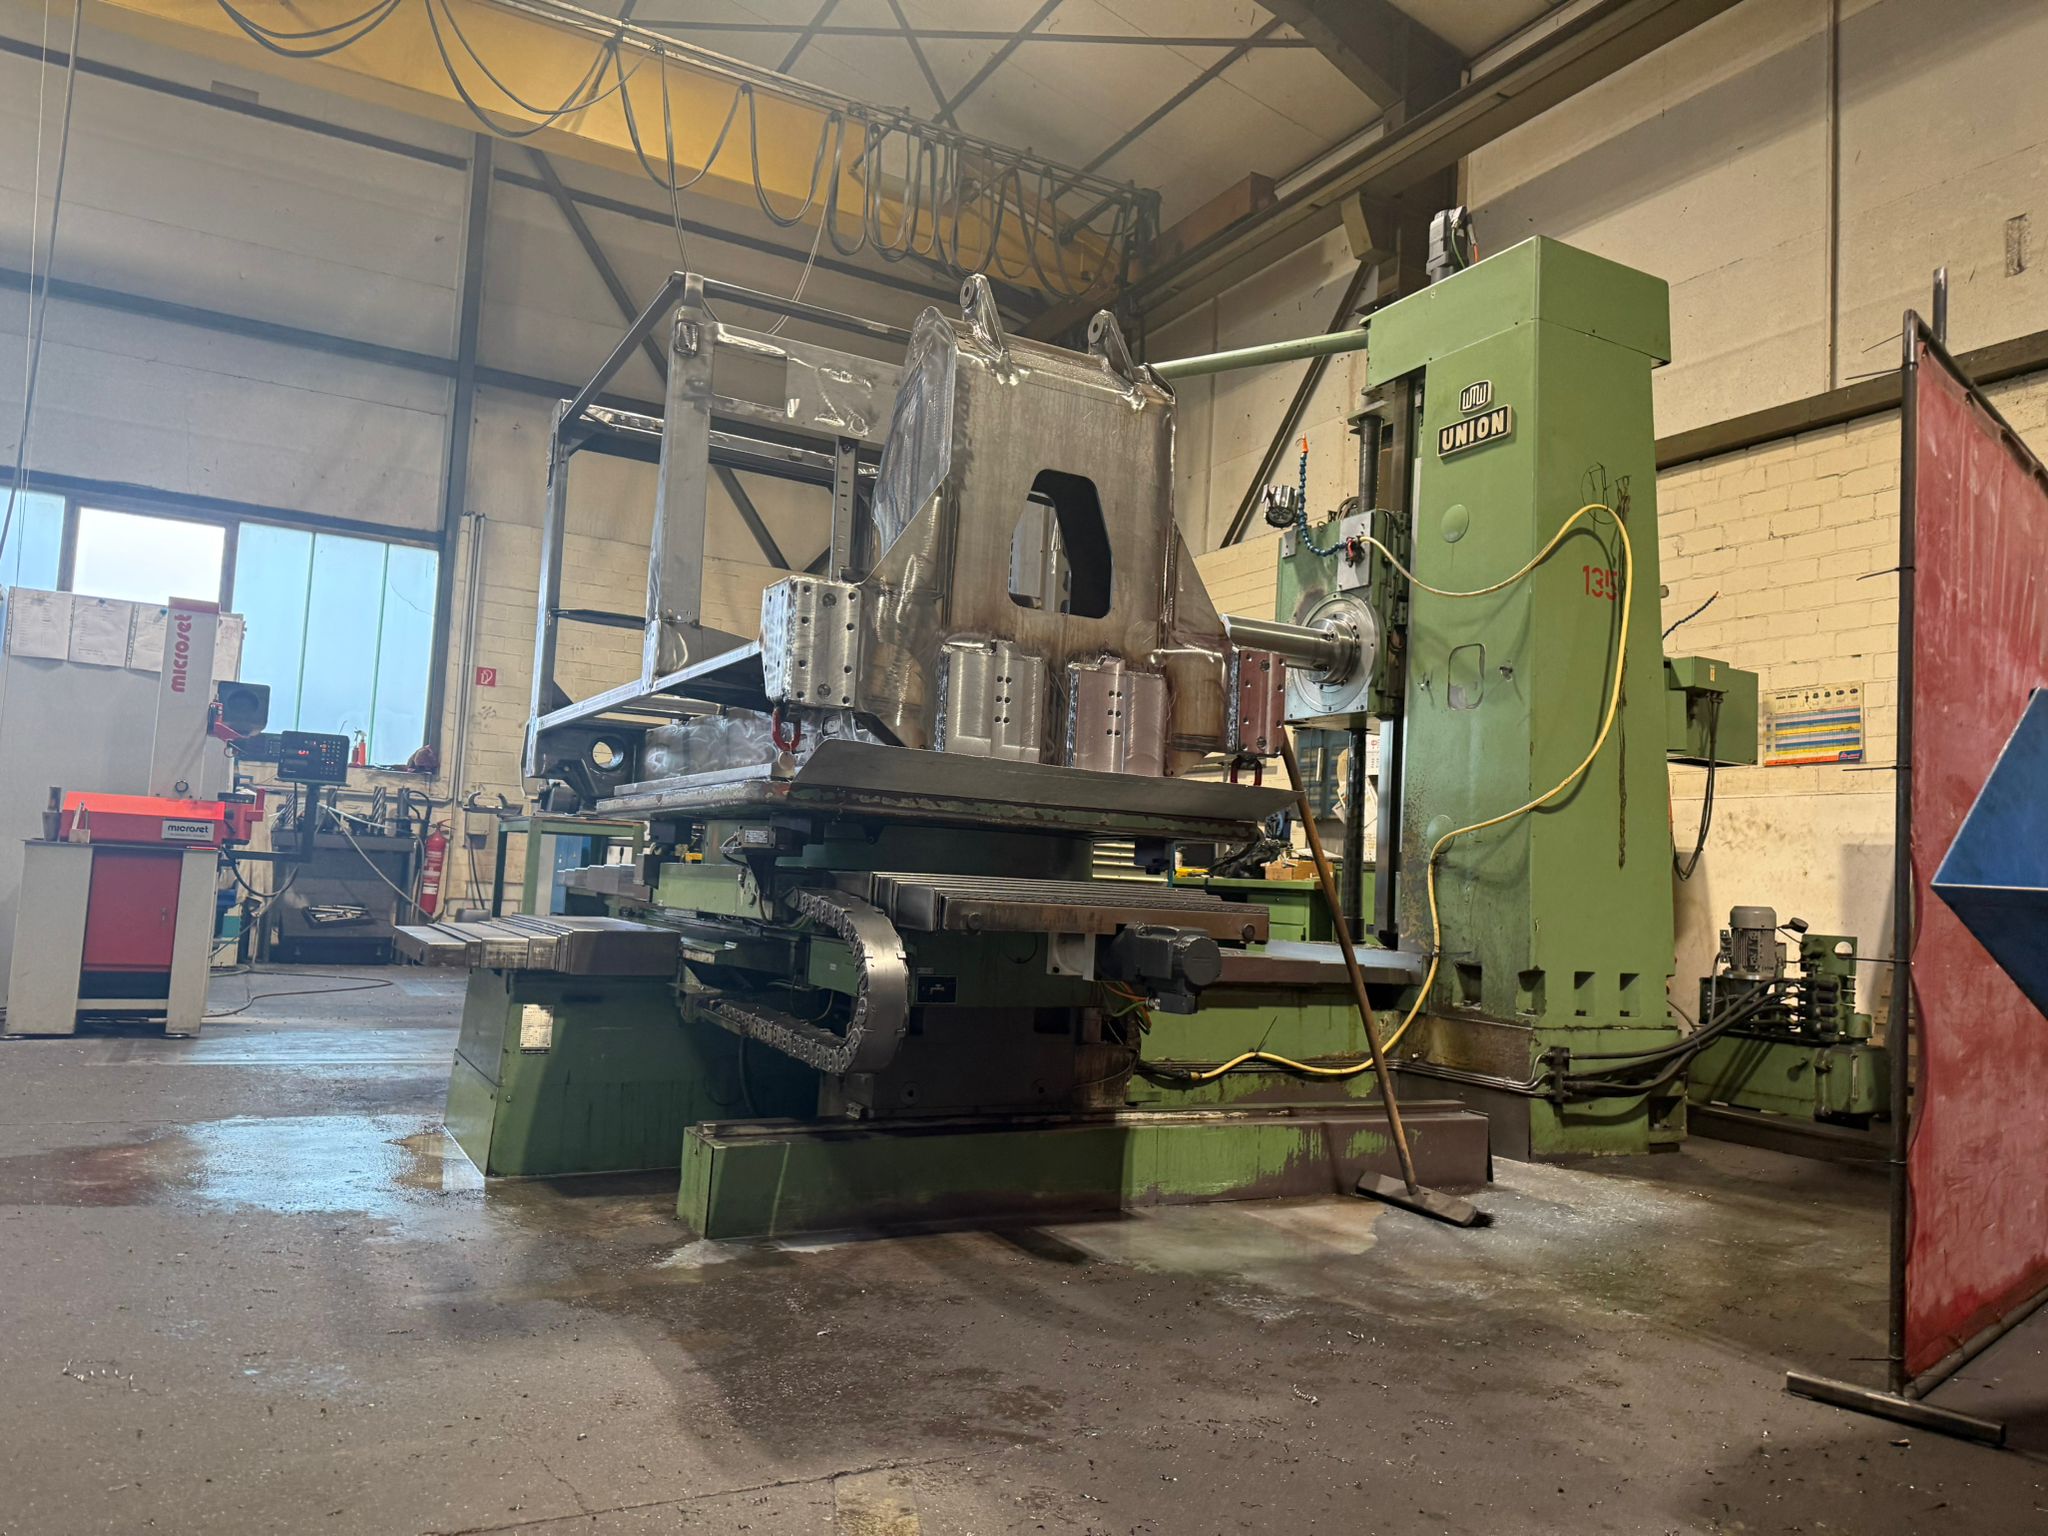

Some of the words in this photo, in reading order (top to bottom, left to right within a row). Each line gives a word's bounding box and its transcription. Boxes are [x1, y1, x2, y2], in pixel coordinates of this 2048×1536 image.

[1462, 383, 1487, 410] WMW
[1441, 409, 1505, 451] UNION
[1583, 565, 1617, 601] 135
[171, 614, 192, 693] microset
[168, 824, 209, 834] microset
